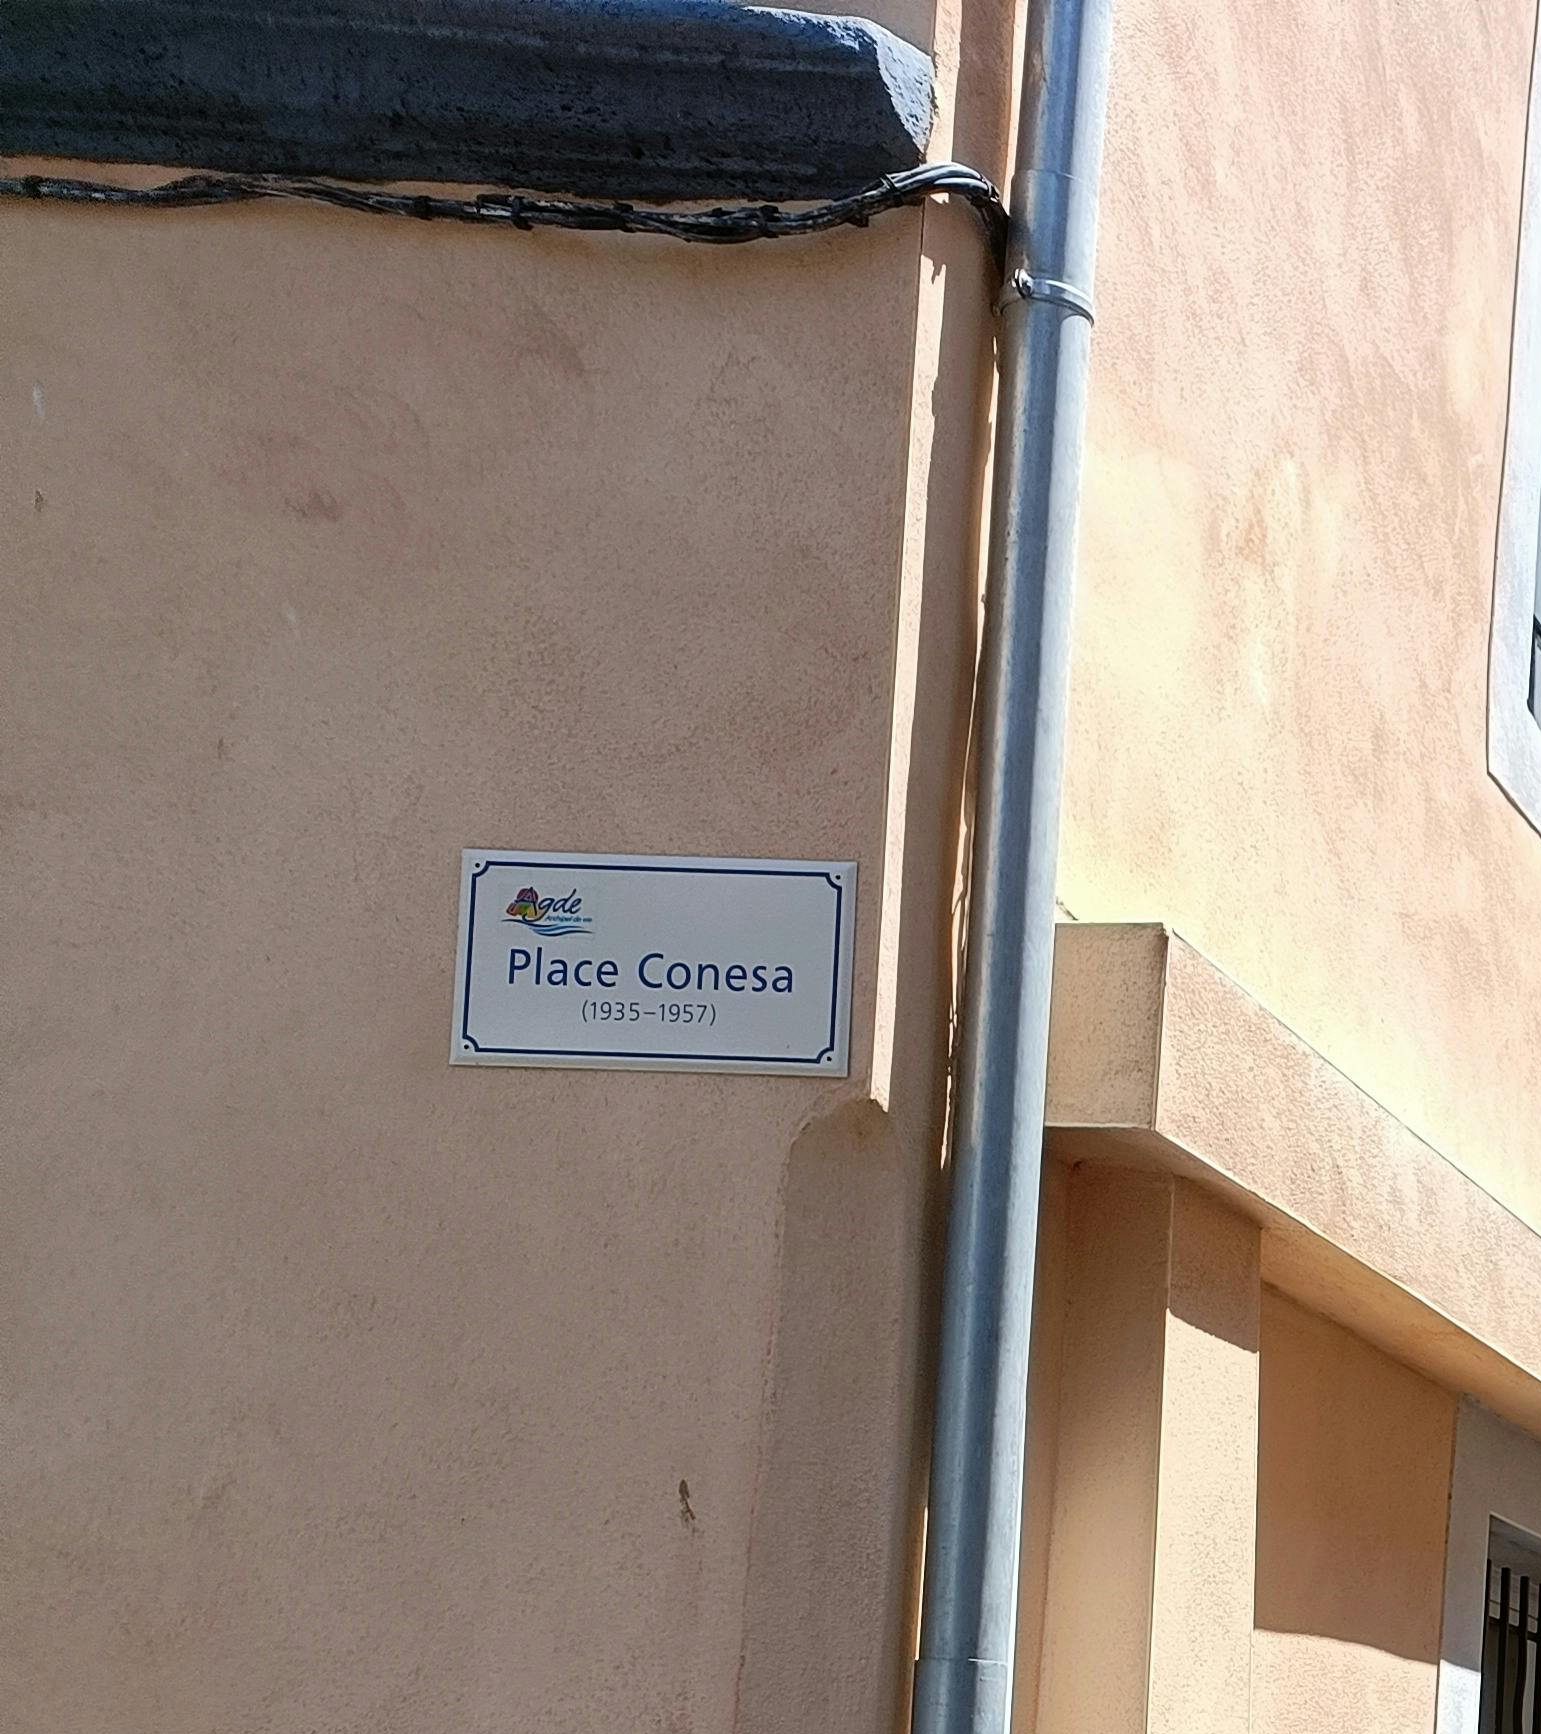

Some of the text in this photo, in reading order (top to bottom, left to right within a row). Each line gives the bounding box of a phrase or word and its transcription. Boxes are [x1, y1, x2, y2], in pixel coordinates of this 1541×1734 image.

[506, 887, 582, 922] Agde
[508, 947, 793, 993] Place Conesa
